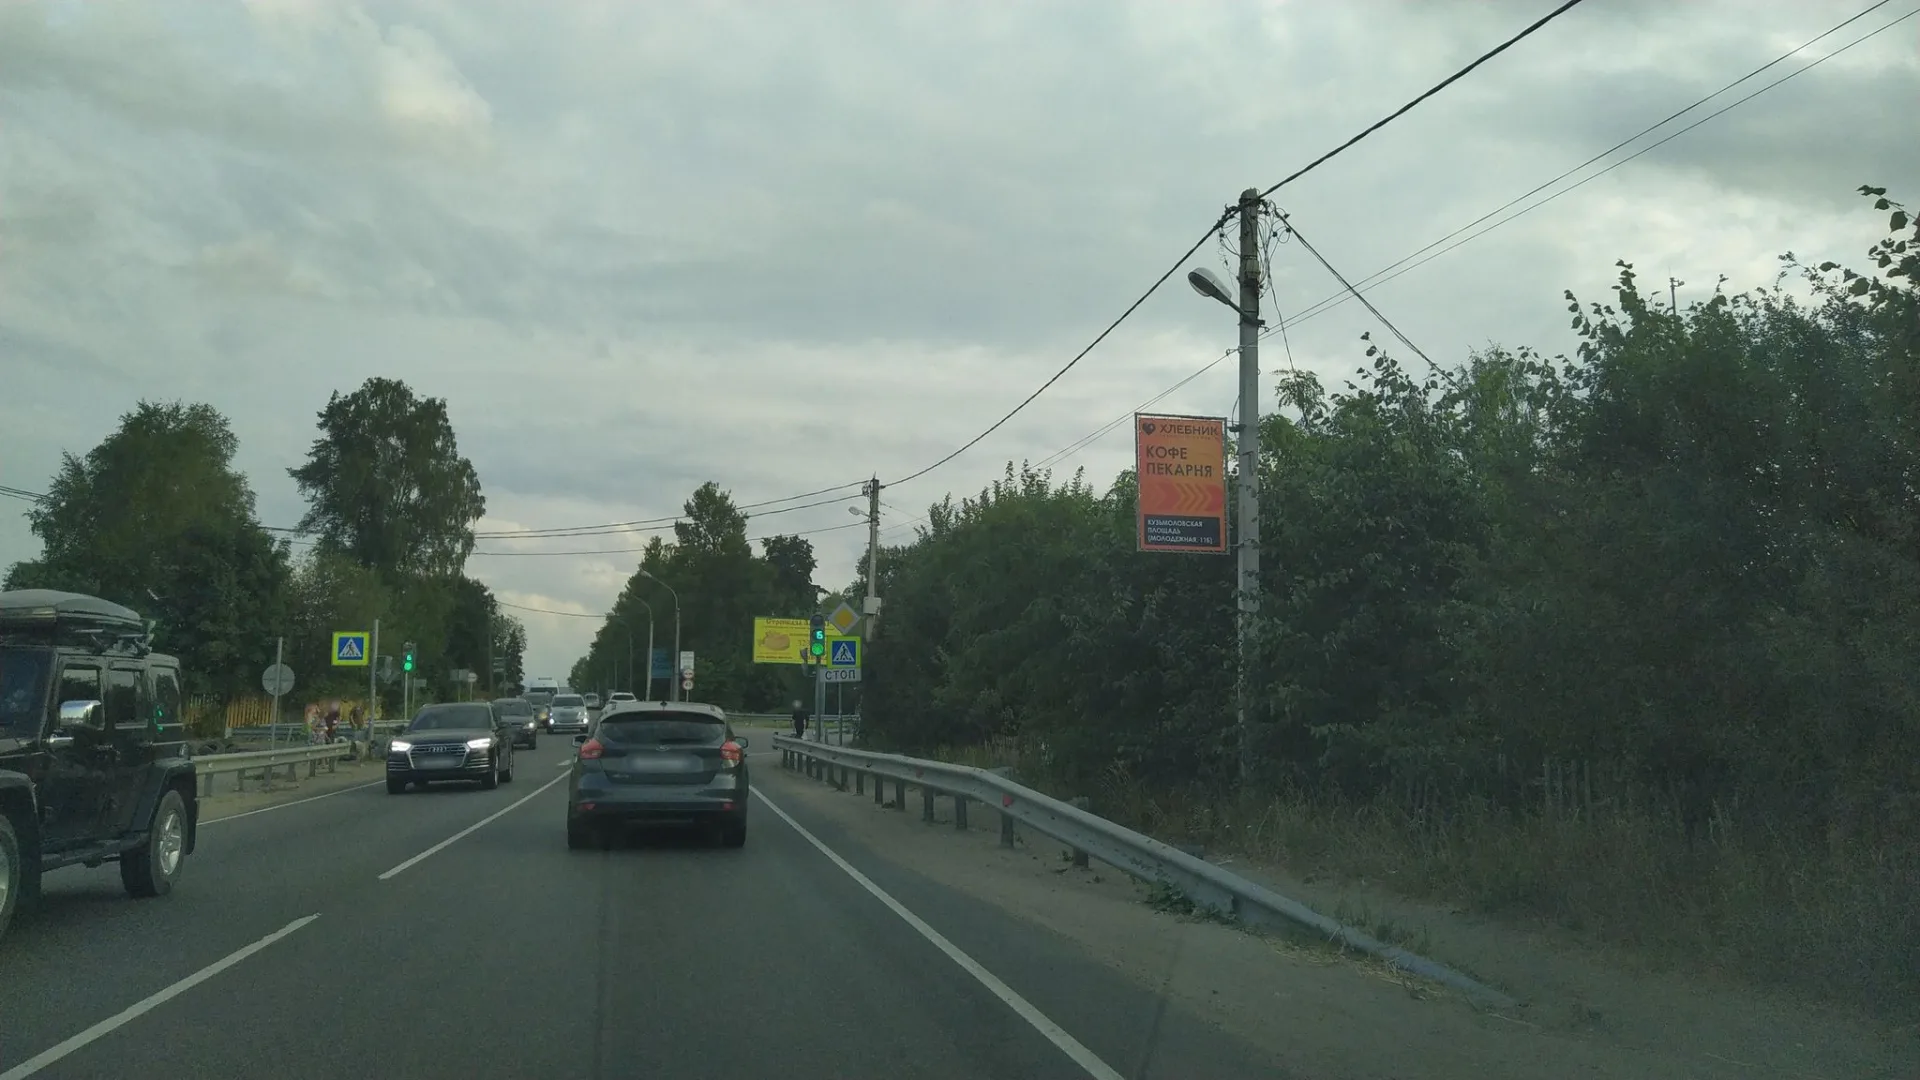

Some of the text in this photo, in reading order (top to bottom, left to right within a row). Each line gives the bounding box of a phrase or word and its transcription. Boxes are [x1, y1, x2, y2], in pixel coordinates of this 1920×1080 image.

[1160, 424, 1219, 436] ХЛЕБНИК
[1146, 445, 1188, 460] КОФЕ
[1146, 463, 1213, 478] ПЕКАРНЯ
[1147, 519, 1203, 528] КУЗЬМОЛОВСКАЯ
[1147, 527, 1181, 535] ПЛОЩАДЬ
[825, 670, 856, 680] СТОП
